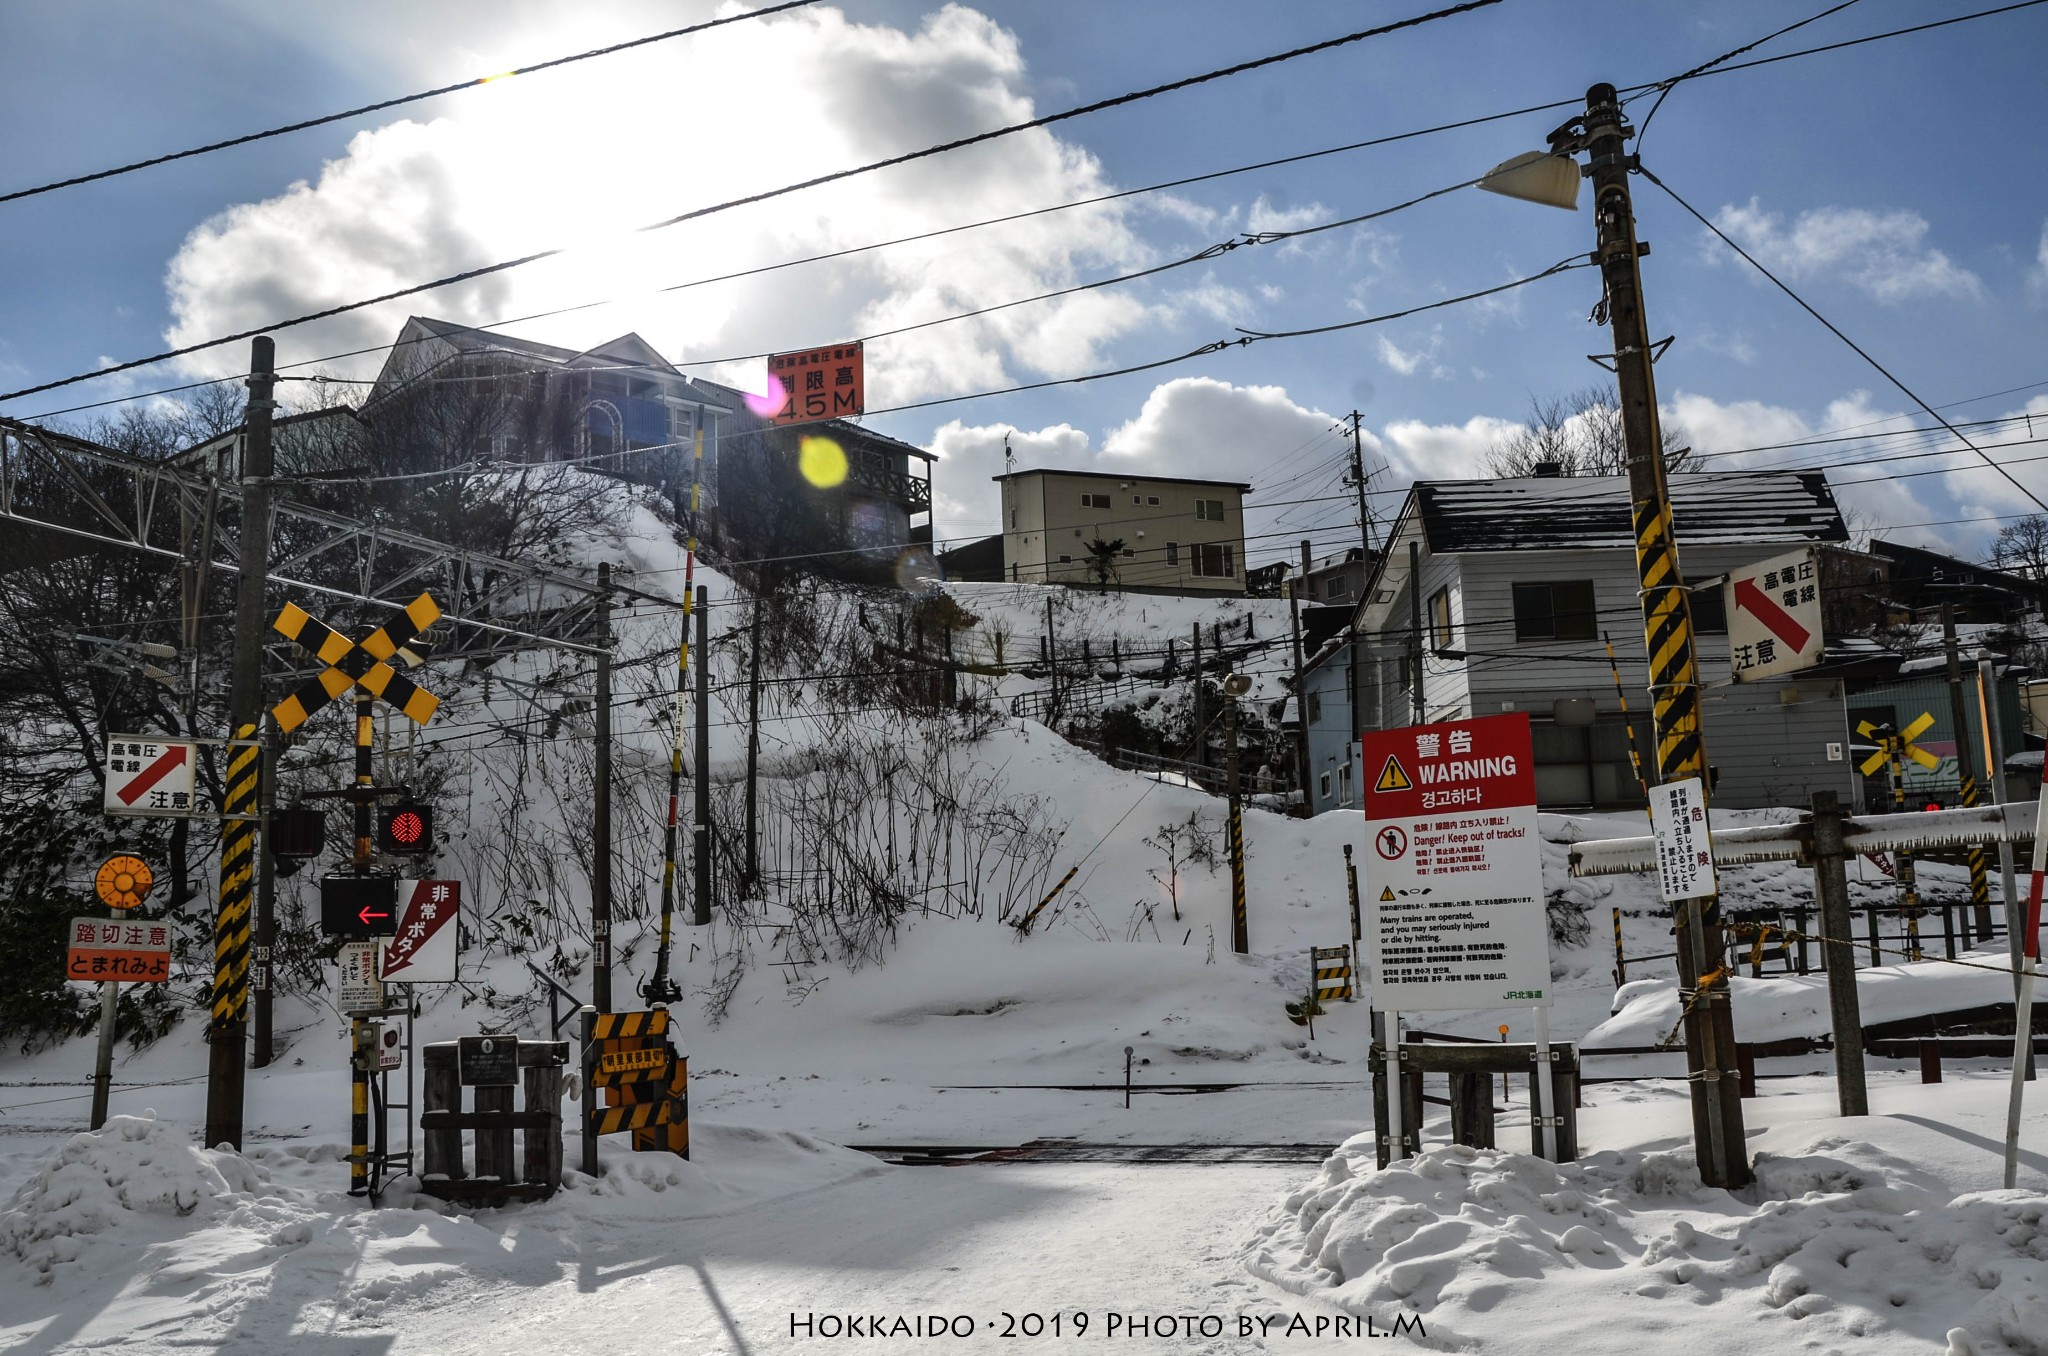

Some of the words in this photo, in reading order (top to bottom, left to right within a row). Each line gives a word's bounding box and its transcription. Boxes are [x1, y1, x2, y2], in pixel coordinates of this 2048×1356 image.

[777, 388, 856, 420] 4.5M
[1763, 560, 1815, 591] 高電圧
[1782, 584, 1816, 608] 電線
[1734, 638, 1777, 671] 注意
[111, 743, 158, 757] 高電圧
[1416, 729, 1473, 758] 警告
[111, 760, 141, 773] 電線
[1418, 755, 1517, 785] WARNING
[149, 790, 190, 809] 注意
[1421, 786, 1482, 809] 경고하다
[1414, 834, 1445, 847] Danger!
[1448, 832, 1468, 844] Keep
[1470, 832, 1484, 842] out
[1486, 830, 1495, 840] of
[1497, 828, 1526, 839] tracks!
[1668, 847, 1680, 894] 禁止します
[388, 885, 450, 968] 非常ボタン
[1380, 916, 1400, 925] Many
[1402, 914, 1422, 923] trains
[1438, 911, 1475, 922] operated,
[1381, 926, 1395, 934] and
[1396, 926, 1409, 935] you
[1411, 925, 1427, 933] may
[1429, 922, 1461, 932] seriously
[1463, 920, 1490, 931] injured
[76, 923, 167, 945] 踏切注意
[1391, 935, 1402, 943] die
[1404, 935, 1413, 944] by
[1415, 934, 1442, 943] hitting.
[71, 955, 165, 975] とまれみよ
[1503, 990, 1543, 1000] JR北海道
